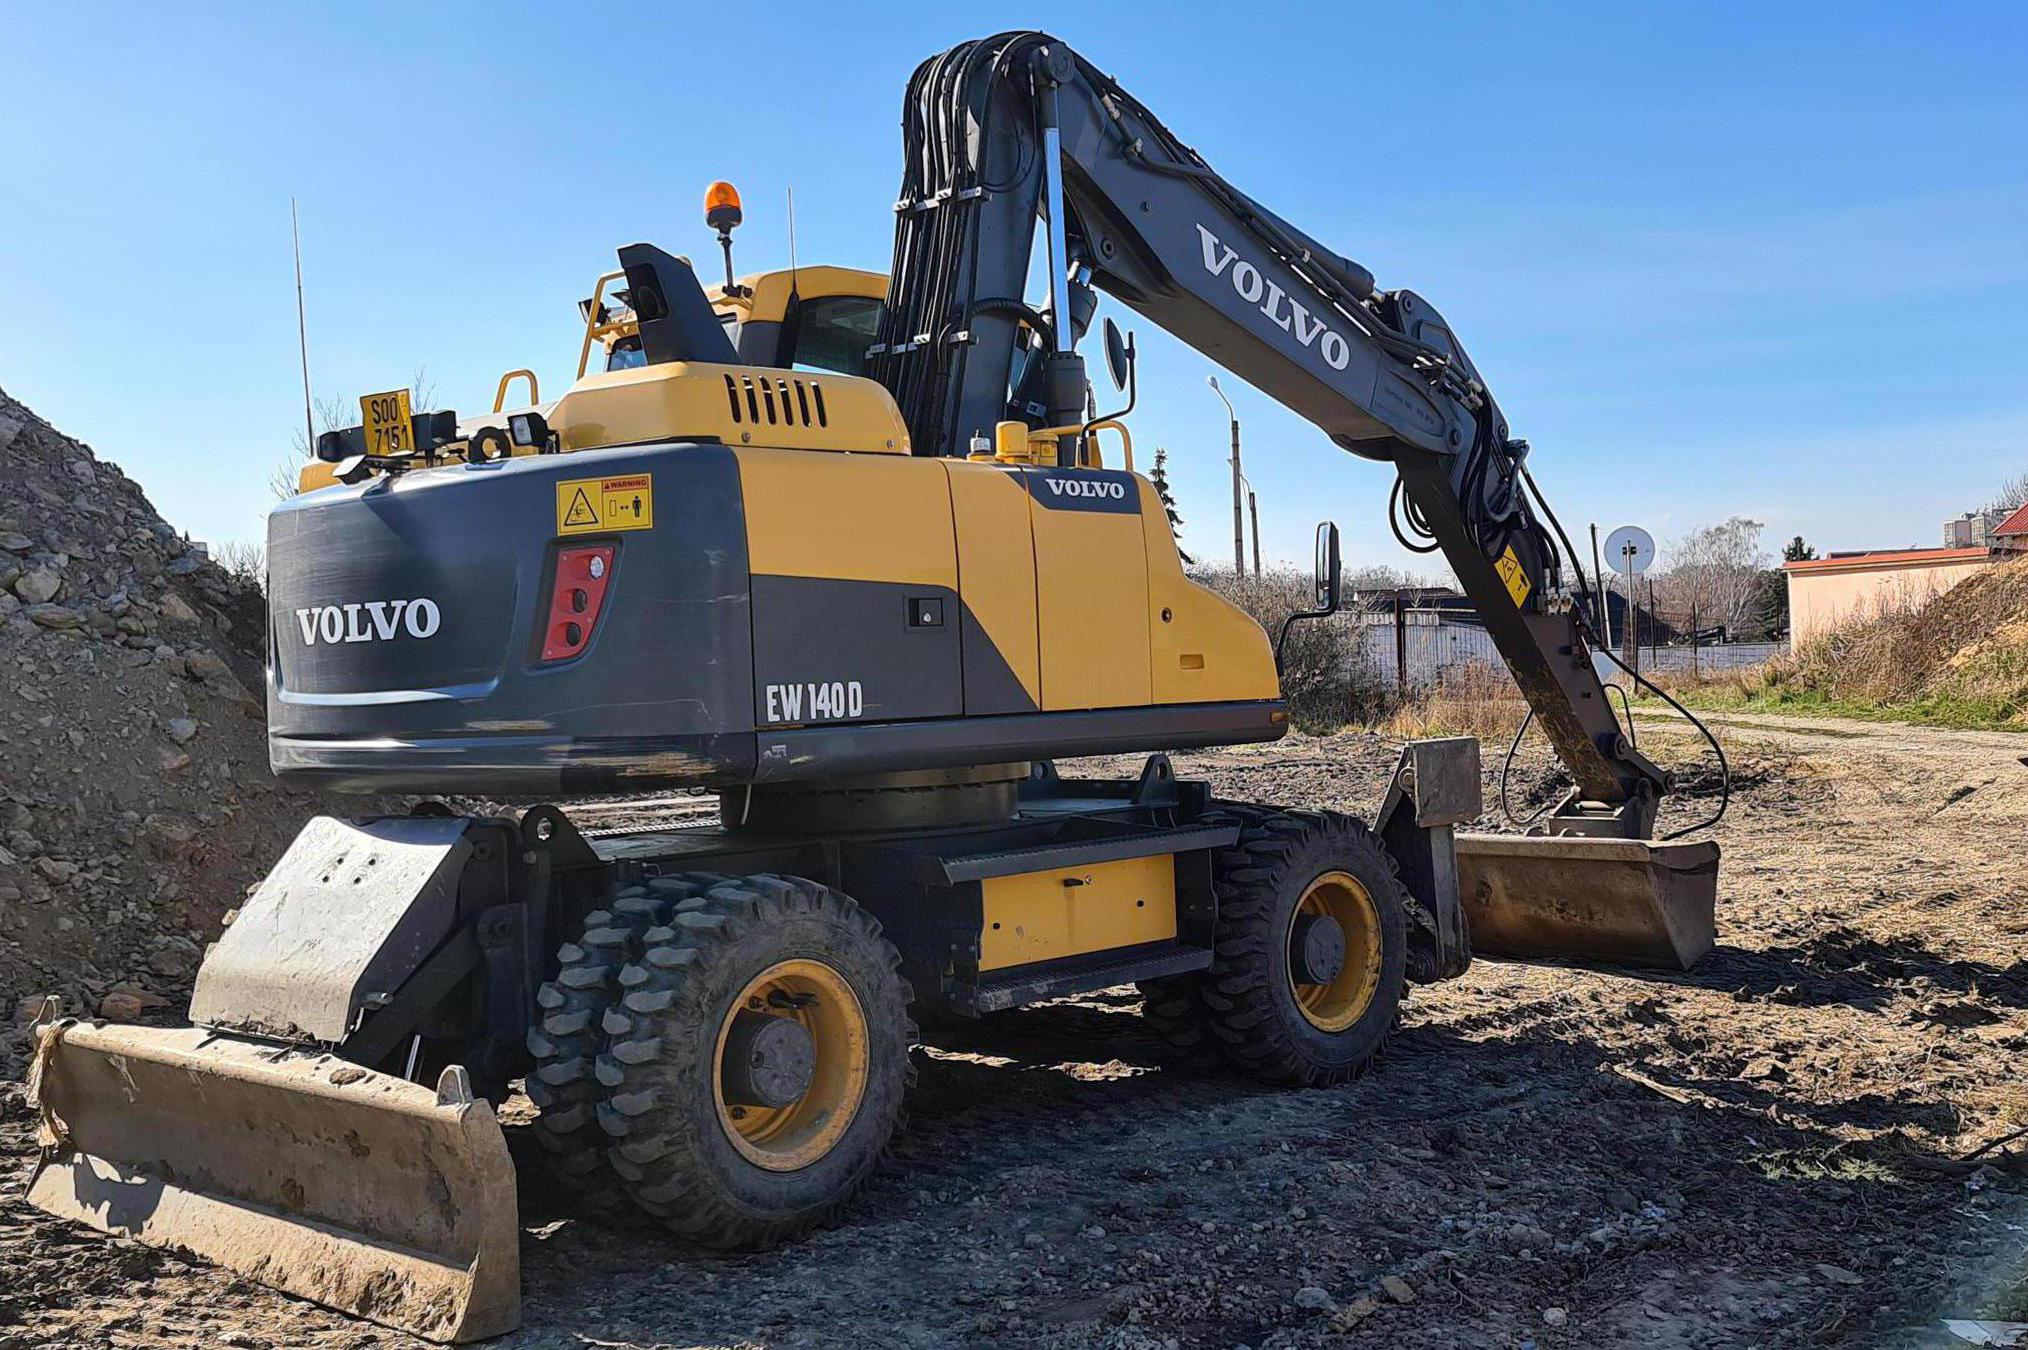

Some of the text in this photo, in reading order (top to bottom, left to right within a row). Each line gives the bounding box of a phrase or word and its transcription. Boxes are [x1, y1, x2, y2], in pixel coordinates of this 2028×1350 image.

[1196, 223, 1350, 371] VOLVO
[610, 480, 647, 489] WARNING
[1045, 479, 1125, 499] VOLVO
[296, 598, 441, 646] VOLVO
